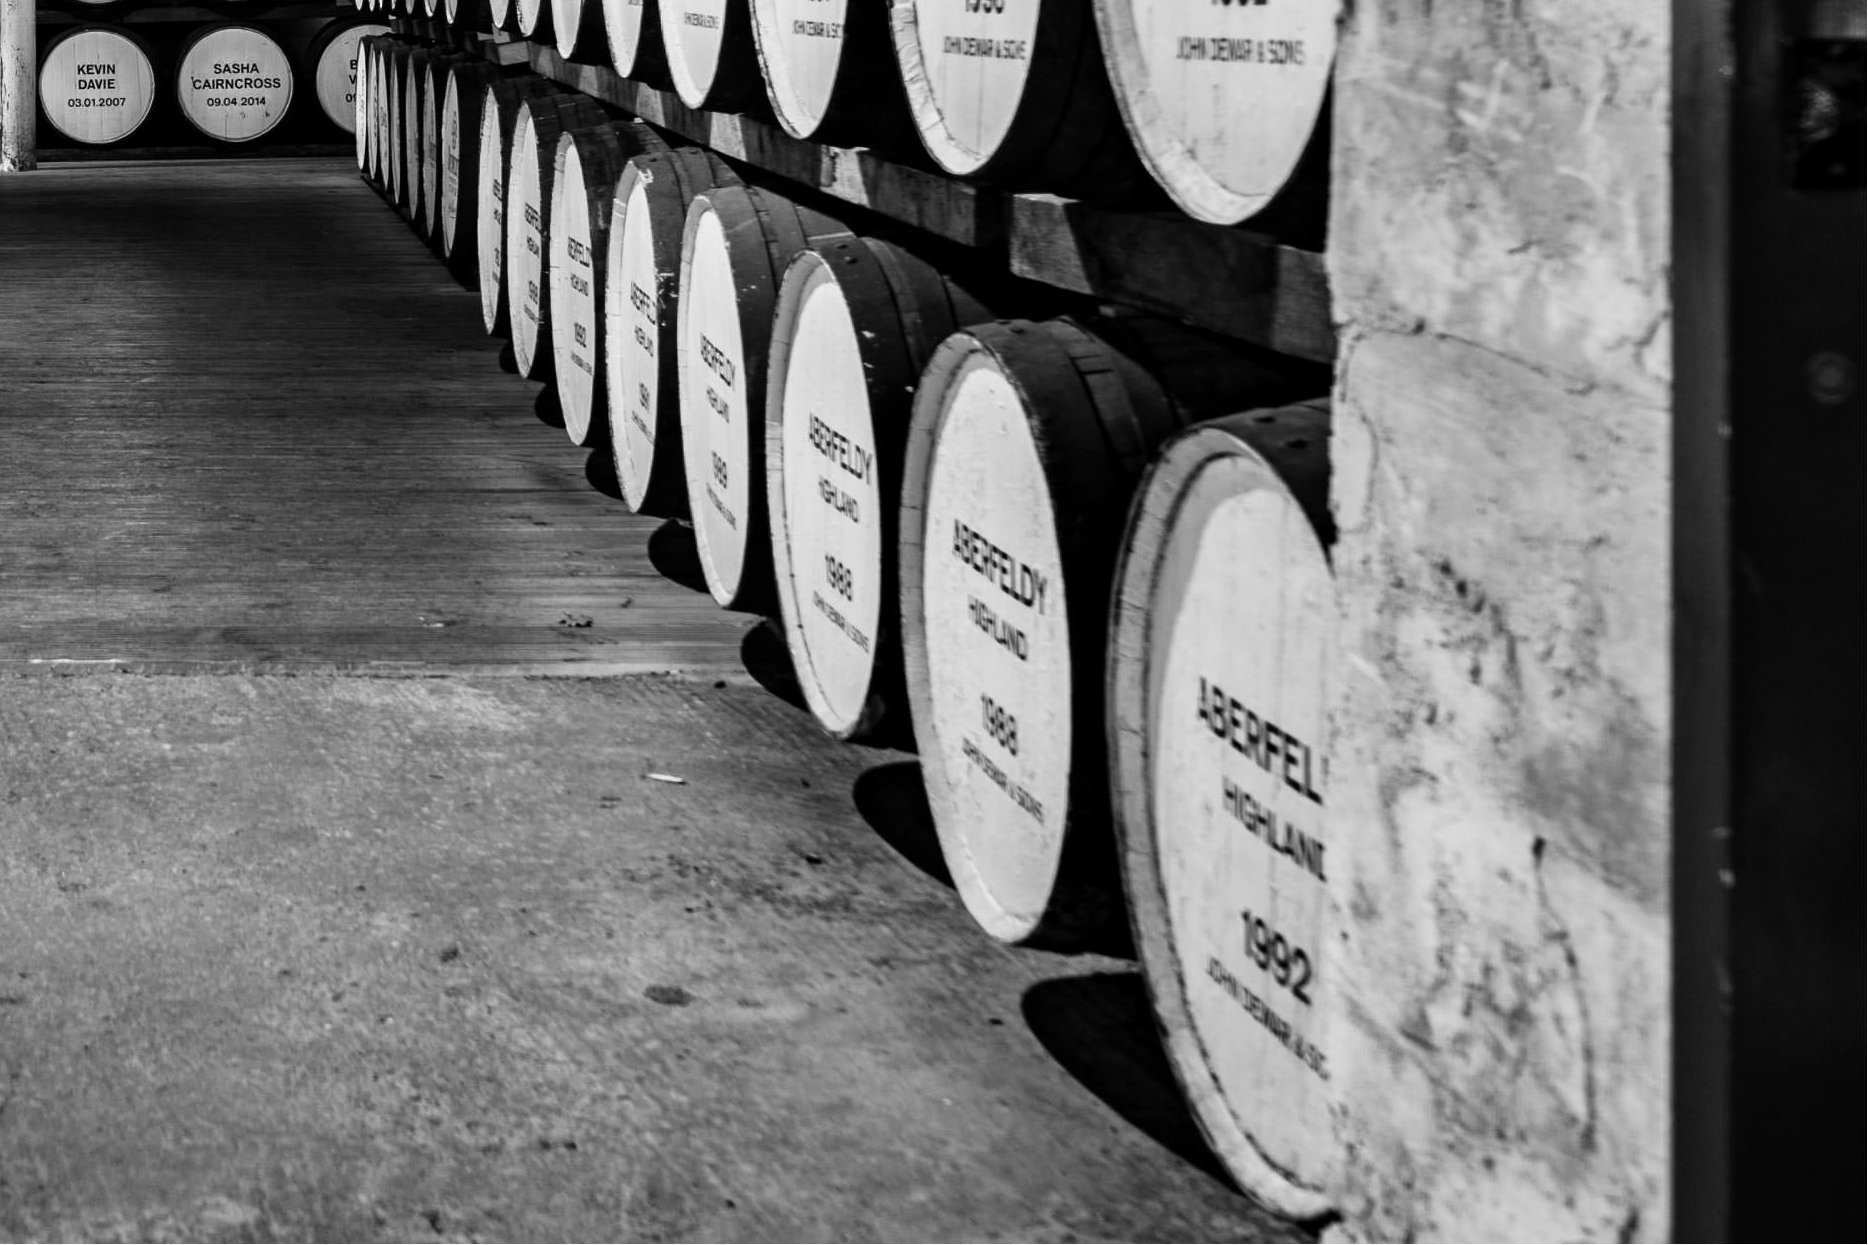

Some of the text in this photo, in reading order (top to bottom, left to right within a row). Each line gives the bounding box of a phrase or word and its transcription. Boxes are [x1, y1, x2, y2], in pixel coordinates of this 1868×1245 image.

[76, 64, 116, 75] KEVIN
[213, 63, 260, 75] SASHA
[942, 35, 1026, 61] JOHN DEWAR SONS
[1176, 36, 1207, 60] JOHN
[1210, 37, 1252, 62] DEWAR
[1268, 39, 1306, 65] SONS
[67, 97, 126, 108] 03.01.2007
[78, 78, 116, 90] DAVIE
[192, 77, 282, 90] CAIRNCROSS
[809, 412, 873, 486] ABERFELDY
[818, 474, 860, 523] HIGHLAND
[824, 553, 854, 603] 1988
[952, 518, 1048, 616] ABERFELDY
[967, 594, 1030, 662] HIGHLAND
[979, 692, 1020, 757] 1988
[1196, 674, 1330, 806] ABERFEL
[1239, 909, 1314, 1007] 1992
[1204, 956, 1293, 1047] JOHN DEWAR
